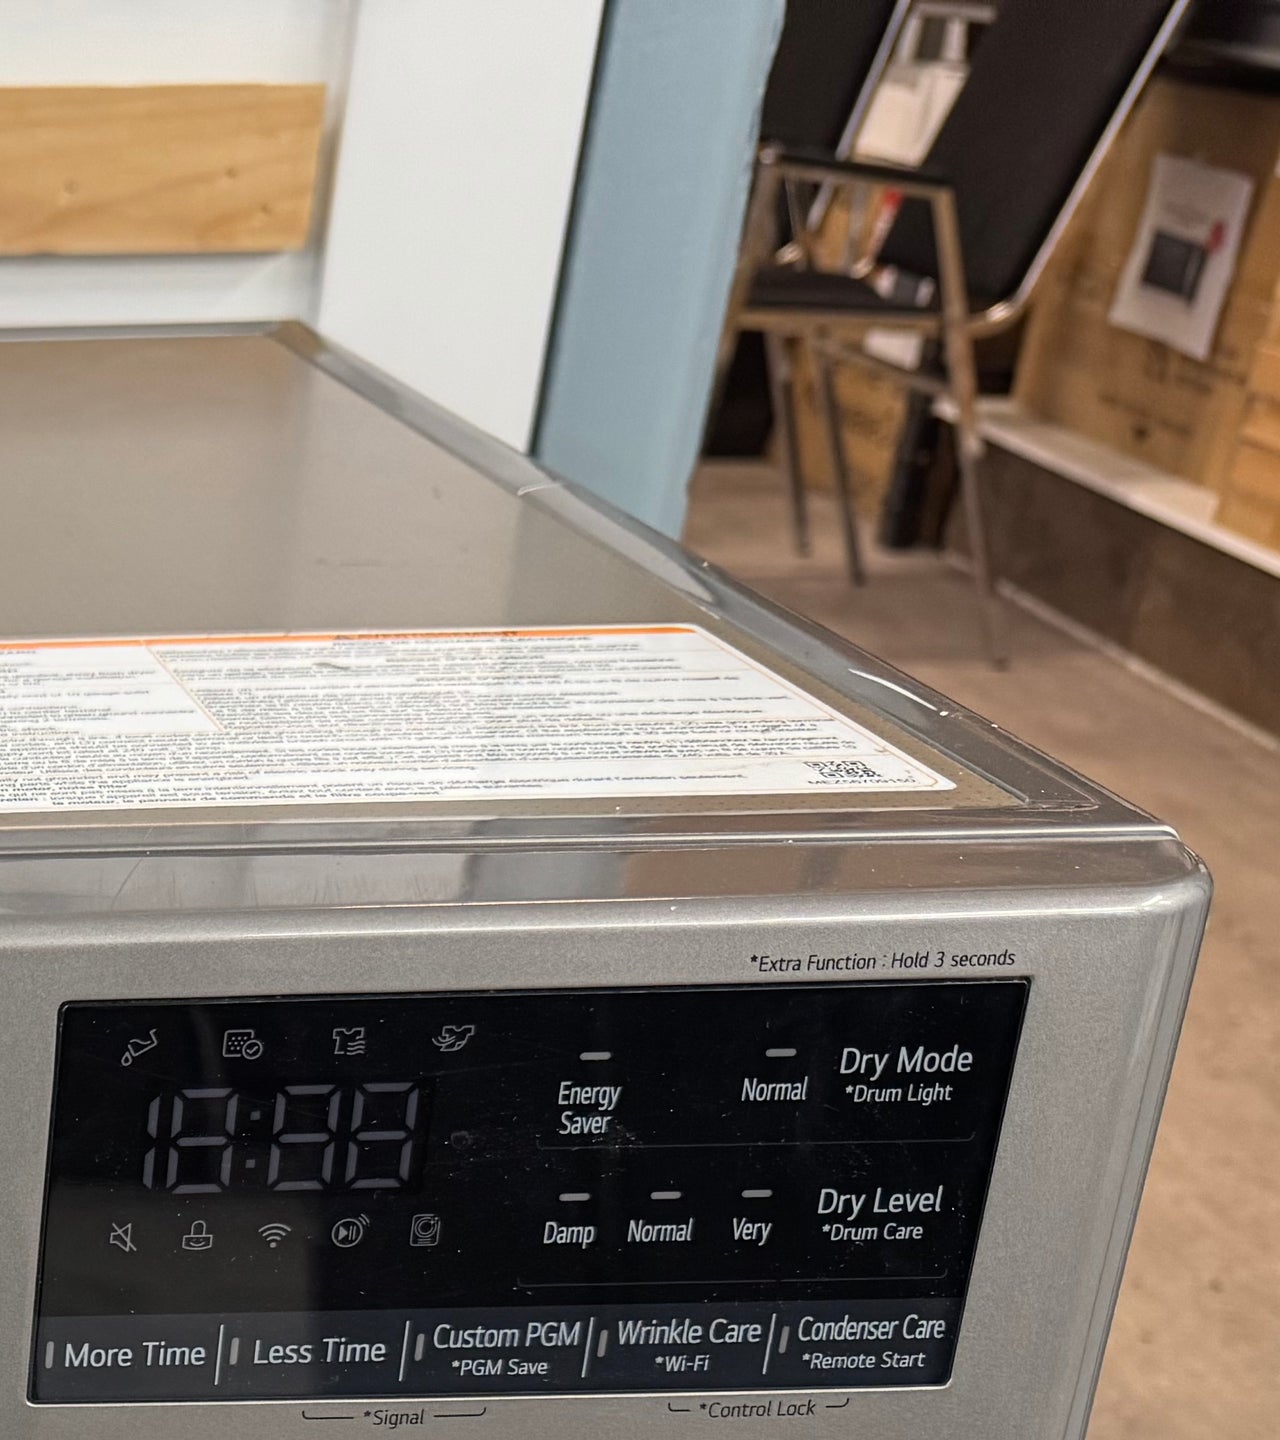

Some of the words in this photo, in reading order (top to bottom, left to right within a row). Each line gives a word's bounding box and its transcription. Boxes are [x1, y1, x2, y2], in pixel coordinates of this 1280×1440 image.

[807, 953, 877, 971] Function
[891, 951, 929, 969] Hold
[934, 951, 945, 968] 3
[951, 949, 1016, 967] seconds
[840, 1047, 888, 1080] Dry
[897, 1044, 973, 1073] Mode
[558, 1080, 622, 1110] Energy
[742, 1076, 808, 1102] Normal
[907, 1083, 953, 1106] Light
[559, 1111, 612, 1134] Saver
[818, 1188, 866, 1221] Dry
[874, 1185, 943, 1213] Level
[543, 1221, 595, 1249] Damp
[628, 1218, 694, 1244] Normal
[732, 1218, 772, 1245] Very
[883, 1222, 923, 1241] Care
[433, 1323, 519, 1349] Custom
[525, 1321, 581, 1347] PGM
[618, 1319, 701, 1346] Wrinkle
[710, 1319, 761, 1344] Care
[798, 1315, 896, 1342] Condenser
[903, 1314, 945, 1340] Care
[65, 1343, 133, 1368] More
[143, 1341, 206, 1366] Time
[253, 1339, 312, 1364] Less
[323, 1337, 386, 1362] Time
[880, 1351, 926, 1368] Start
[508, 1359, 548, 1376] Save
[777, 1400, 815, 1416] Lock
